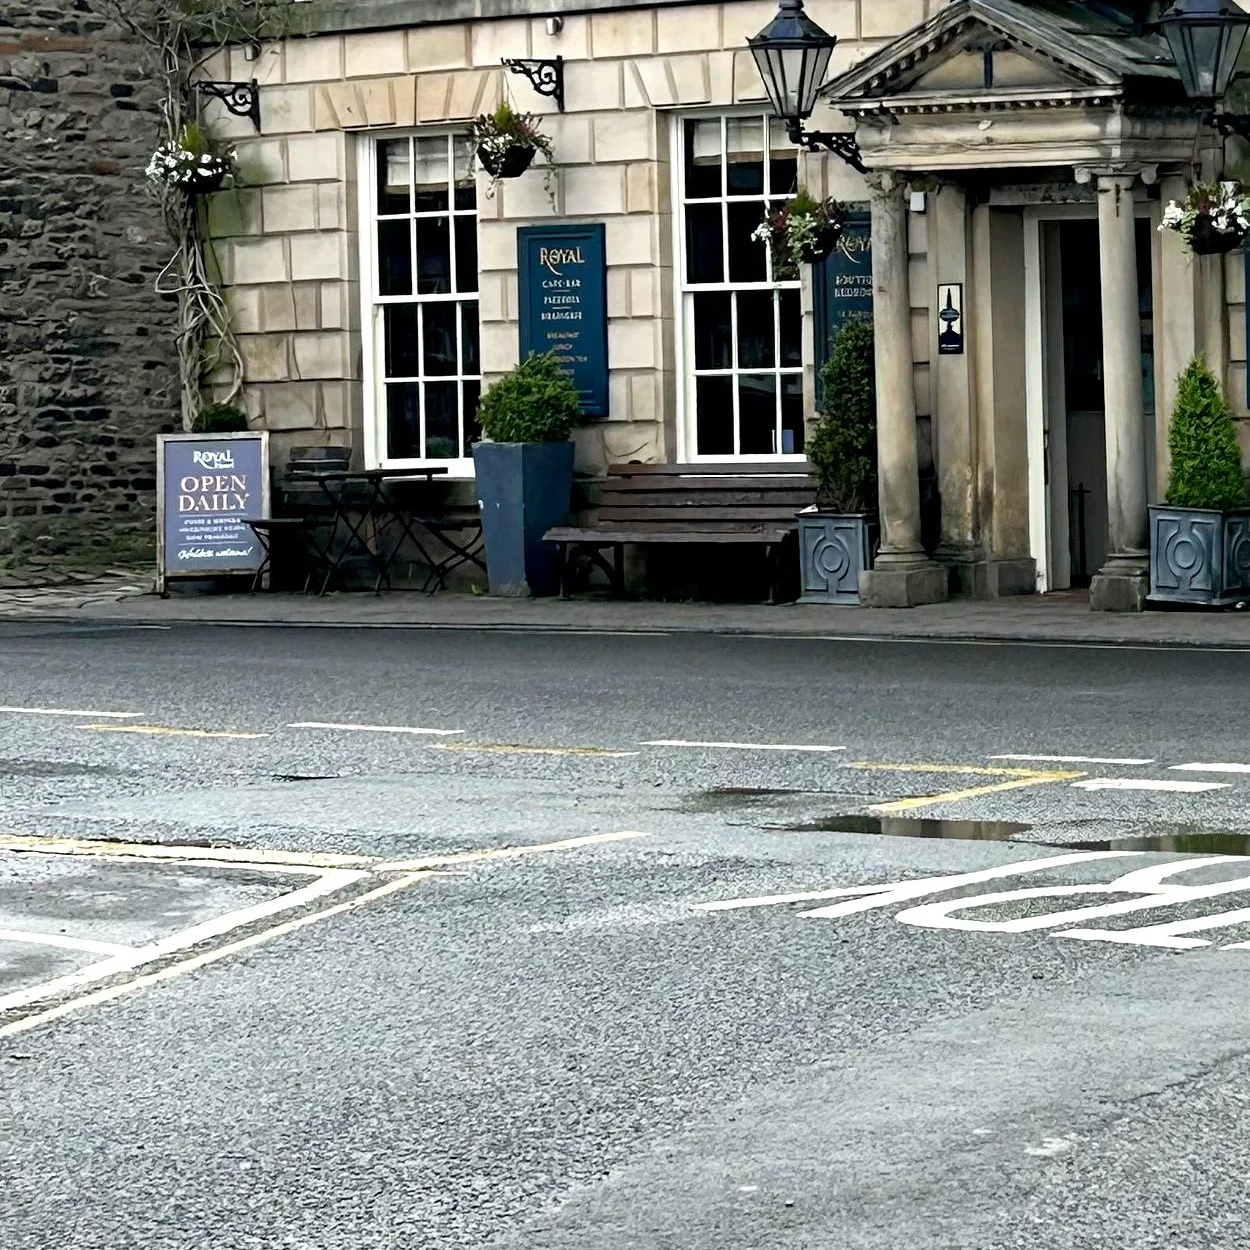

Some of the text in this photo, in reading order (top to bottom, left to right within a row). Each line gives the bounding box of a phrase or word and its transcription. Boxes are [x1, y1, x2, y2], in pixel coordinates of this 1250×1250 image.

[540, 247, 585, 276] ROYAL
[193, 450, 234, 469] ROYAL
[181, 475, 246, 492] OPEN
[178, 493, 250, 511] DAILY
